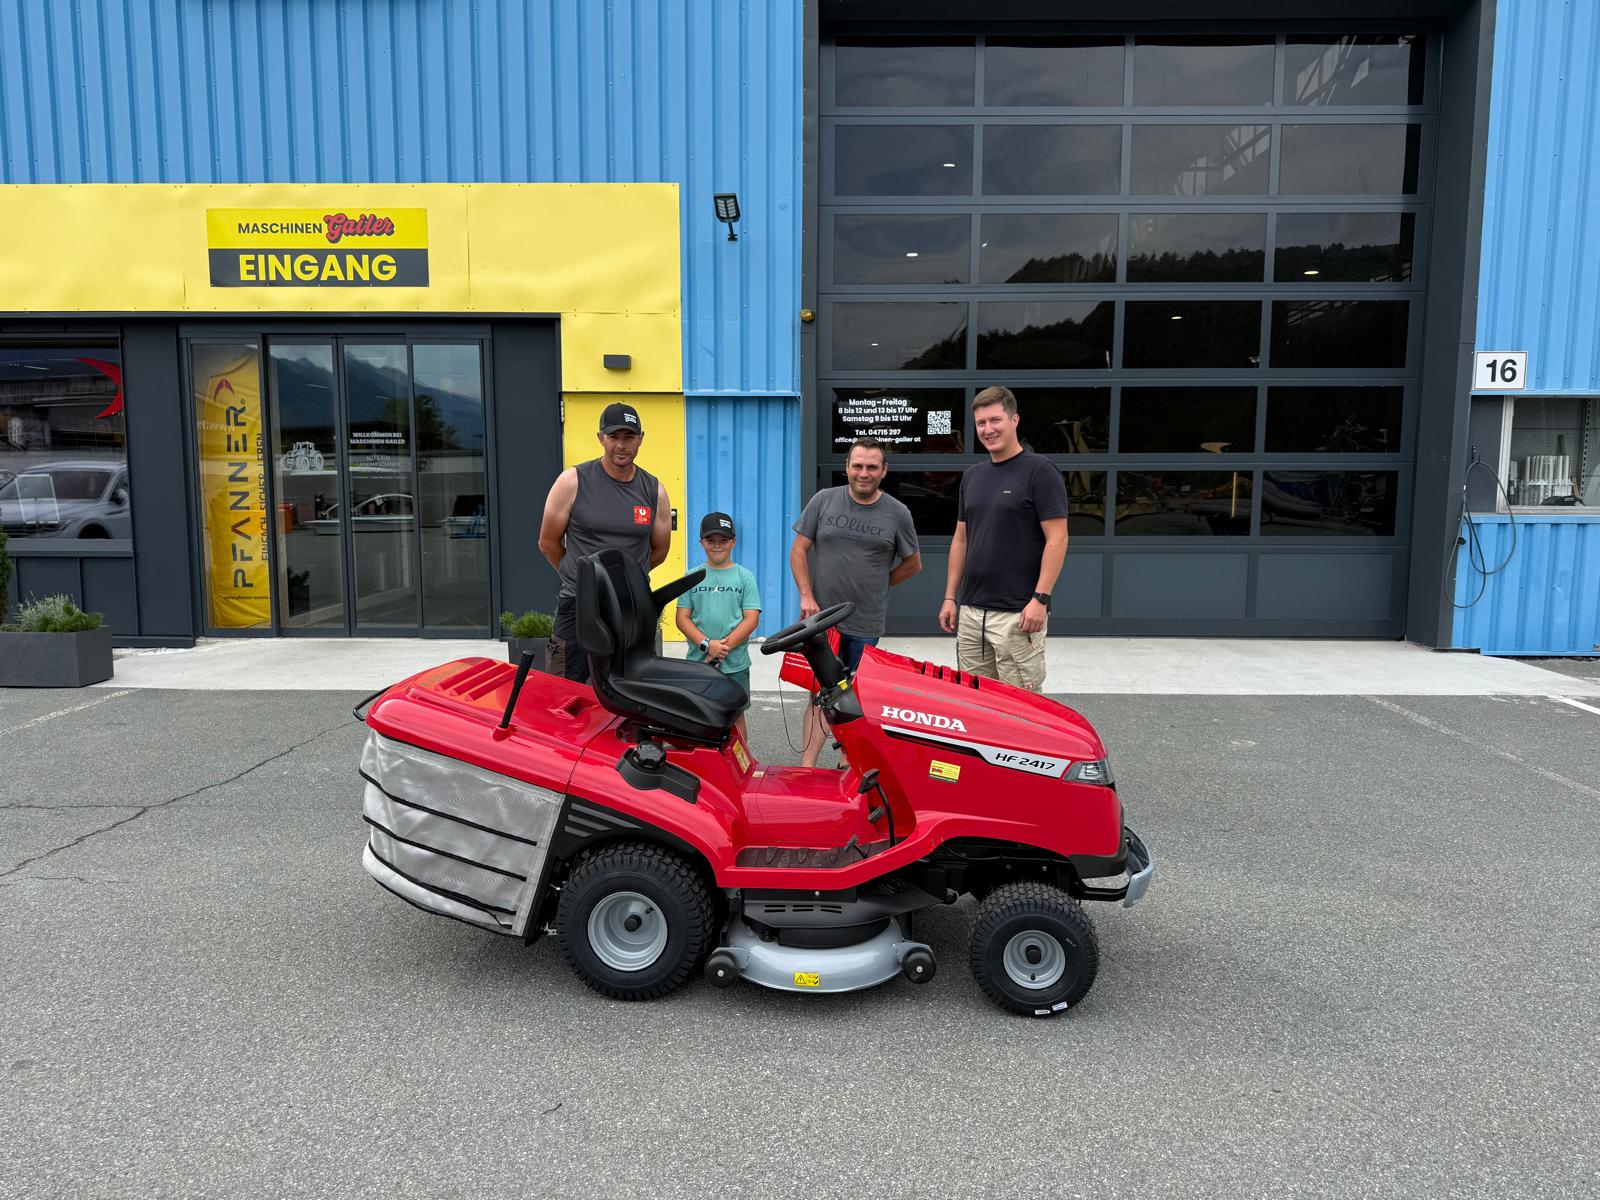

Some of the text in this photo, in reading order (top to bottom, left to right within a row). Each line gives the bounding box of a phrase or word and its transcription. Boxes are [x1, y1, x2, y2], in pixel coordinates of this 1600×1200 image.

[237, 213, 395, 244] MASCHINEN Gailer
[238, 253, 397, 281] EINGANG
[1486, 358, 1517, 383] 16
[848, 398, 877, 407] Montag
[882, 398, 907, 407] Freitag
[842, 415, 874, 423] Samstag
[225, 405, 254, 588] PFANNER
[825, 513, 886, 536] s.Oliver
[690, 586, 742, 594] JORDAN
[880, 705, 967, 733] HONDA
[995, 752, 1056, 770] HF 2417
